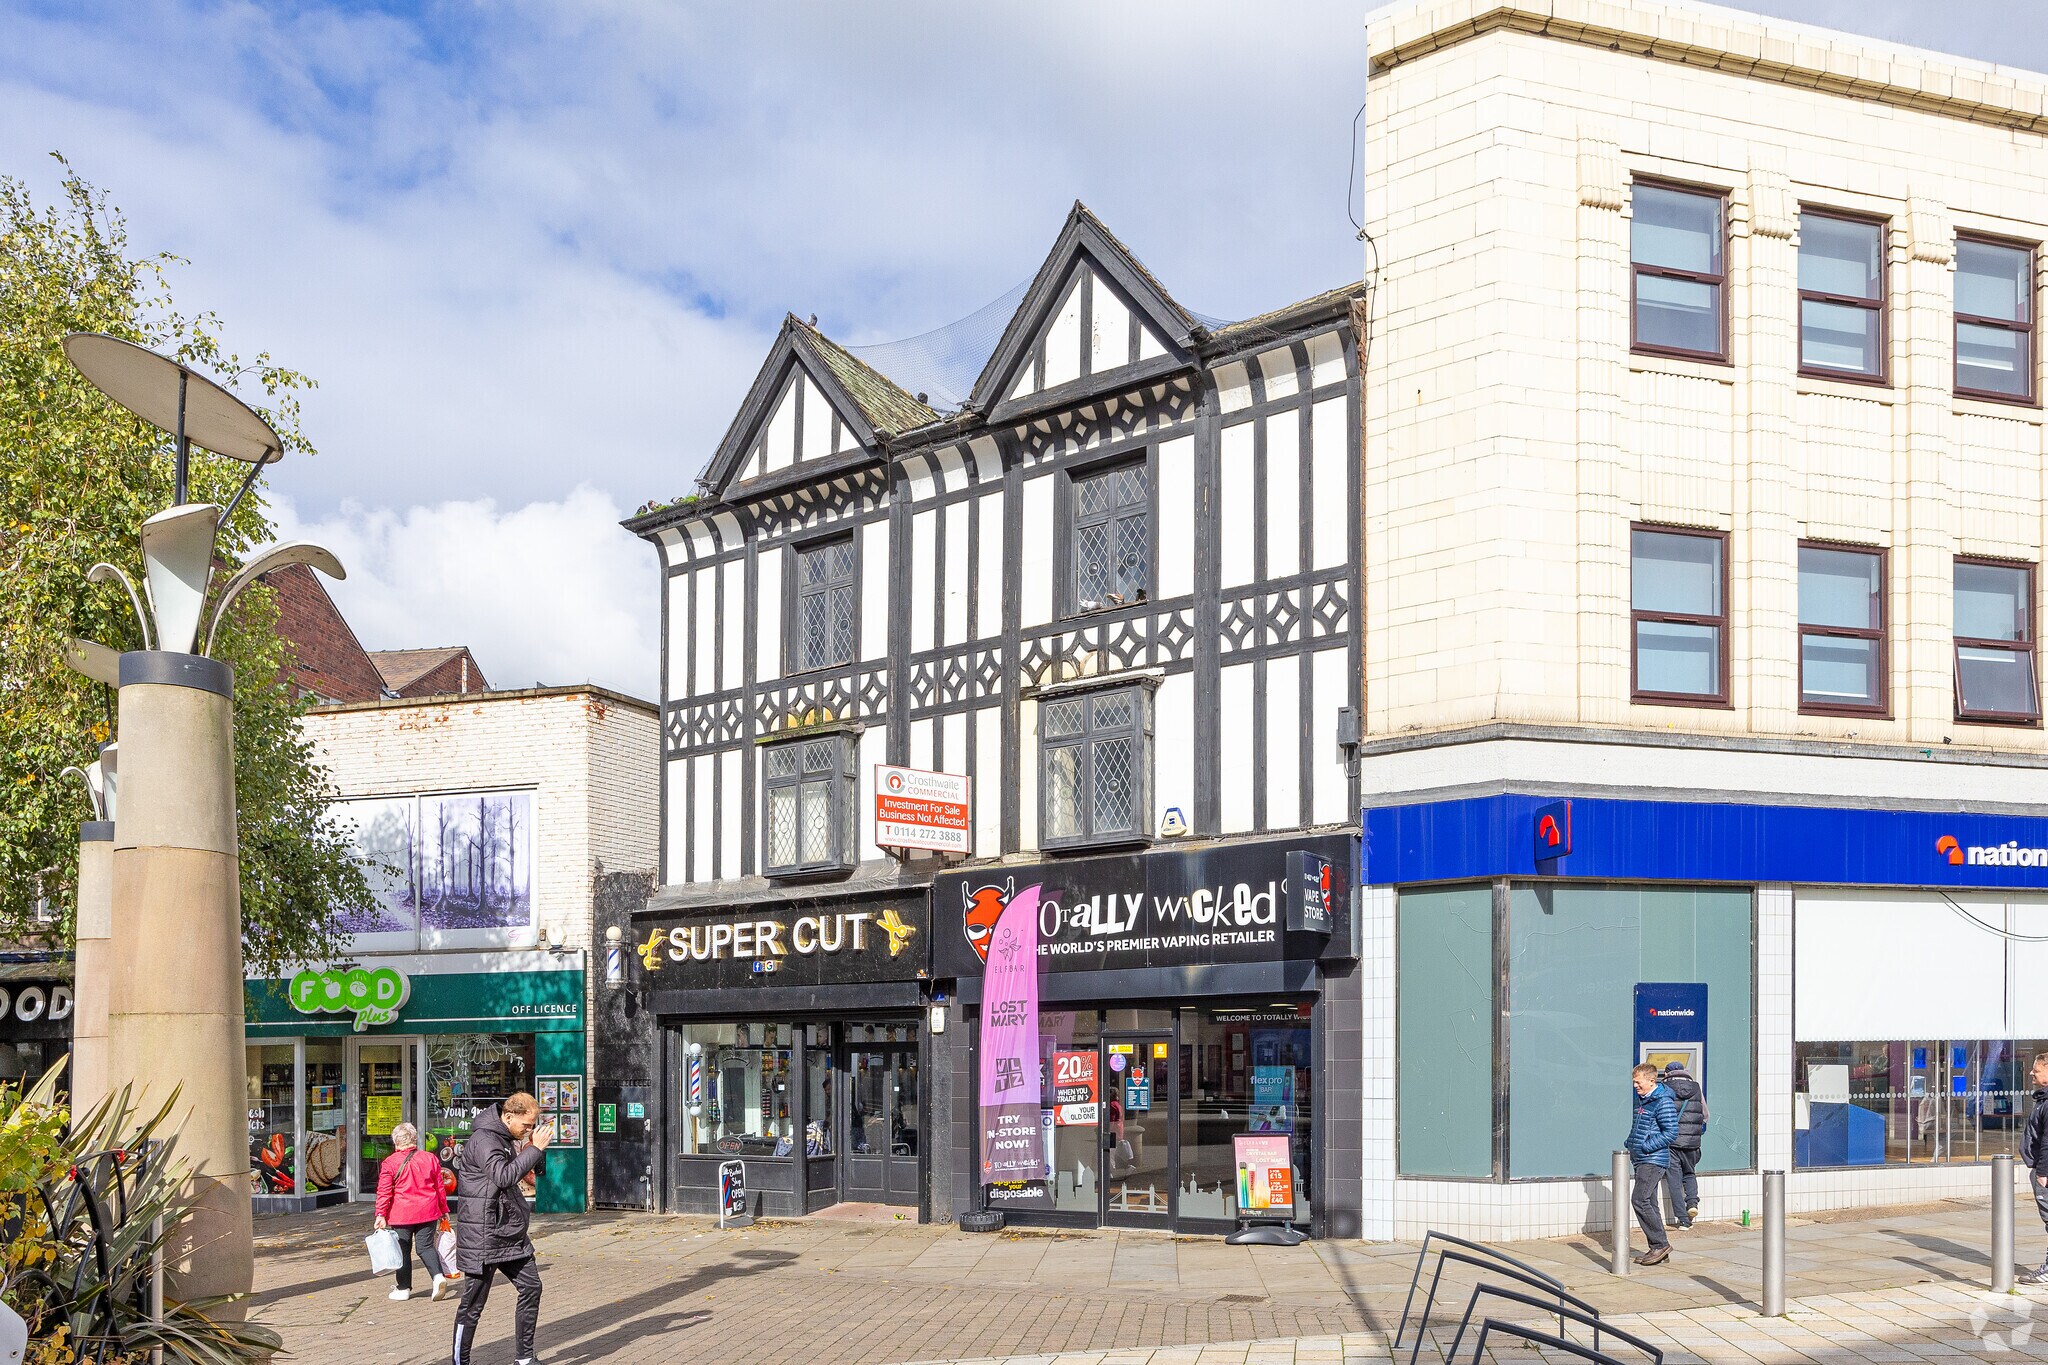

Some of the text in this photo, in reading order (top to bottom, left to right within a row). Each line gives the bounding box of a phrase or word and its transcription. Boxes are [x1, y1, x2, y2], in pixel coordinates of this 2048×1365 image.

[907, 773, 960, 790] Crosthwaite
[907, 786, 960, 800] COMMERCIAL
[884, 798, 961, 815] Investment For Sale
[879, 808, 965, 826] Business Not Affected
[885, 825, 962, 842] T 0114 272 3888
[1304, 888, 1320, 903] VAPE
[1304, 905, 1324, 921] STORE
[668, 913, 871, 962] SUPER CUT
[1050, 941, 1105, 956] WORLD'S
[1106, 936, 1160, 952] PREMIER
[1161, 933, 1211, 949] VAPING
[1213, 930, 1275, 945] RETAILER
[511, 1004, 577, 1014] OFF LICENCE
[991, 1000, 1028, 1014] LOST
[1657, 1009, 1695, 1017] nationwide
[355, 1008, 390, 1031] plus
[991, 1014, 1028, 1028] MARY
[1057, 1055, 1093, 1080] 20%
[1081, 1070, 1093, 1078] OFF
[1250, 1076, 1283, 1086] flex pro
[1057, 1087, 1088, 1096] WHEN YOU
[442, 1106, 468, 1119] Your
[1070, 1113, 1082, 1121] OLD
[998, 1114, 1021, 1125] TRY
[720, 1141, 740, 1150] OPEN
[996, 1140, 1030, 1150] NOW!
[731, 1177, 742, 1187] Shop
[731, 1188, 745, 1199] OPEN
[989, 1187, 1044, 1200] disposable
